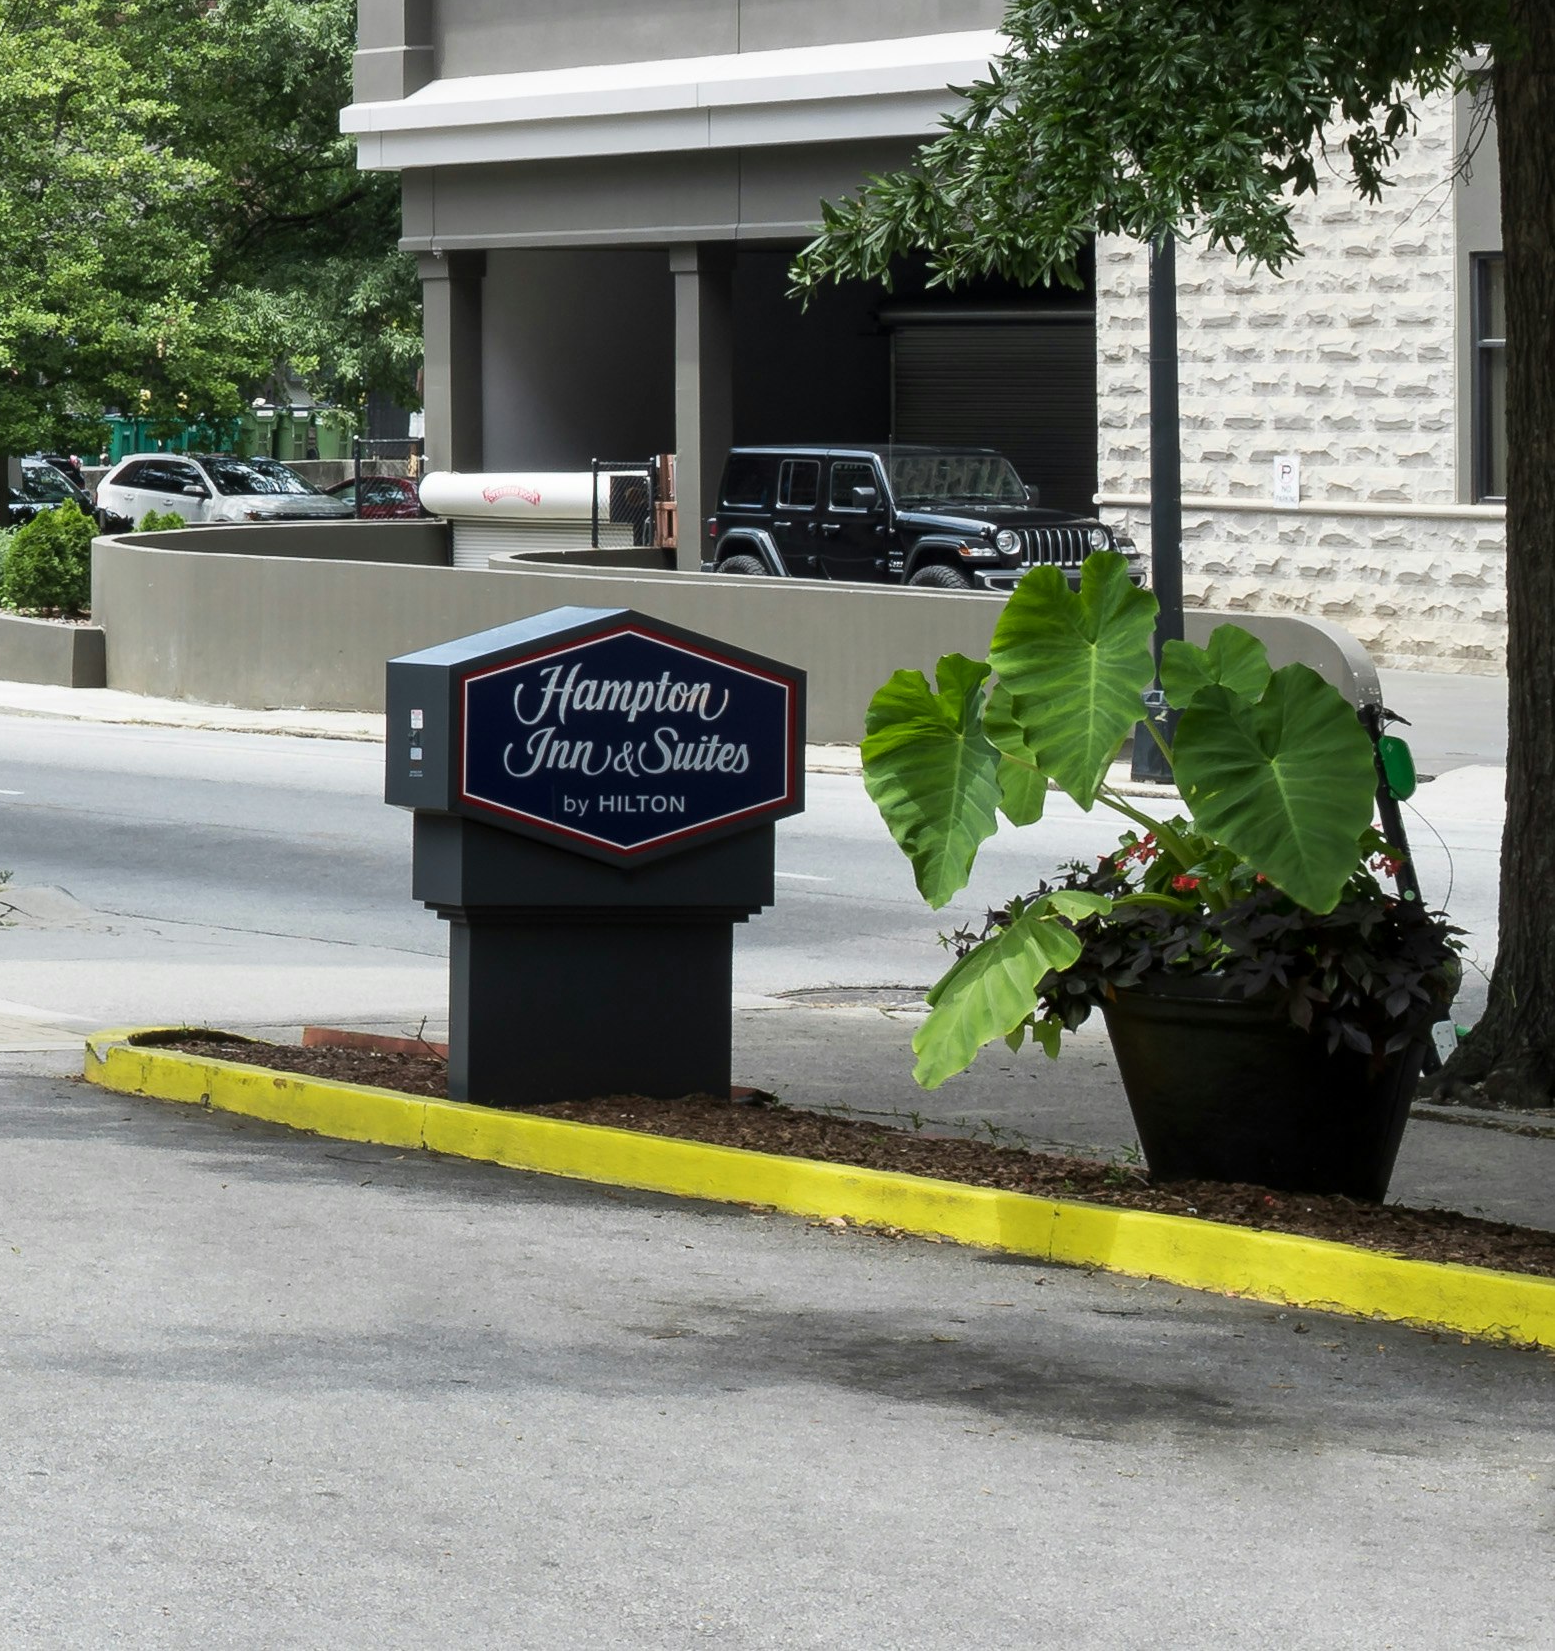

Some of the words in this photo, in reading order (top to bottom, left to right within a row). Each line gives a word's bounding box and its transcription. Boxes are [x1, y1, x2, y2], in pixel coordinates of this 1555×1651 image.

[513, 662, 730, 726] Hampton
[503, 726, 612, 778] Inn
[613, 741, 640, 778] &
[637, 726, 750, 775] Suites
[563, 795, 589, 817] by
[599, 795, 686, 813] HILTON
